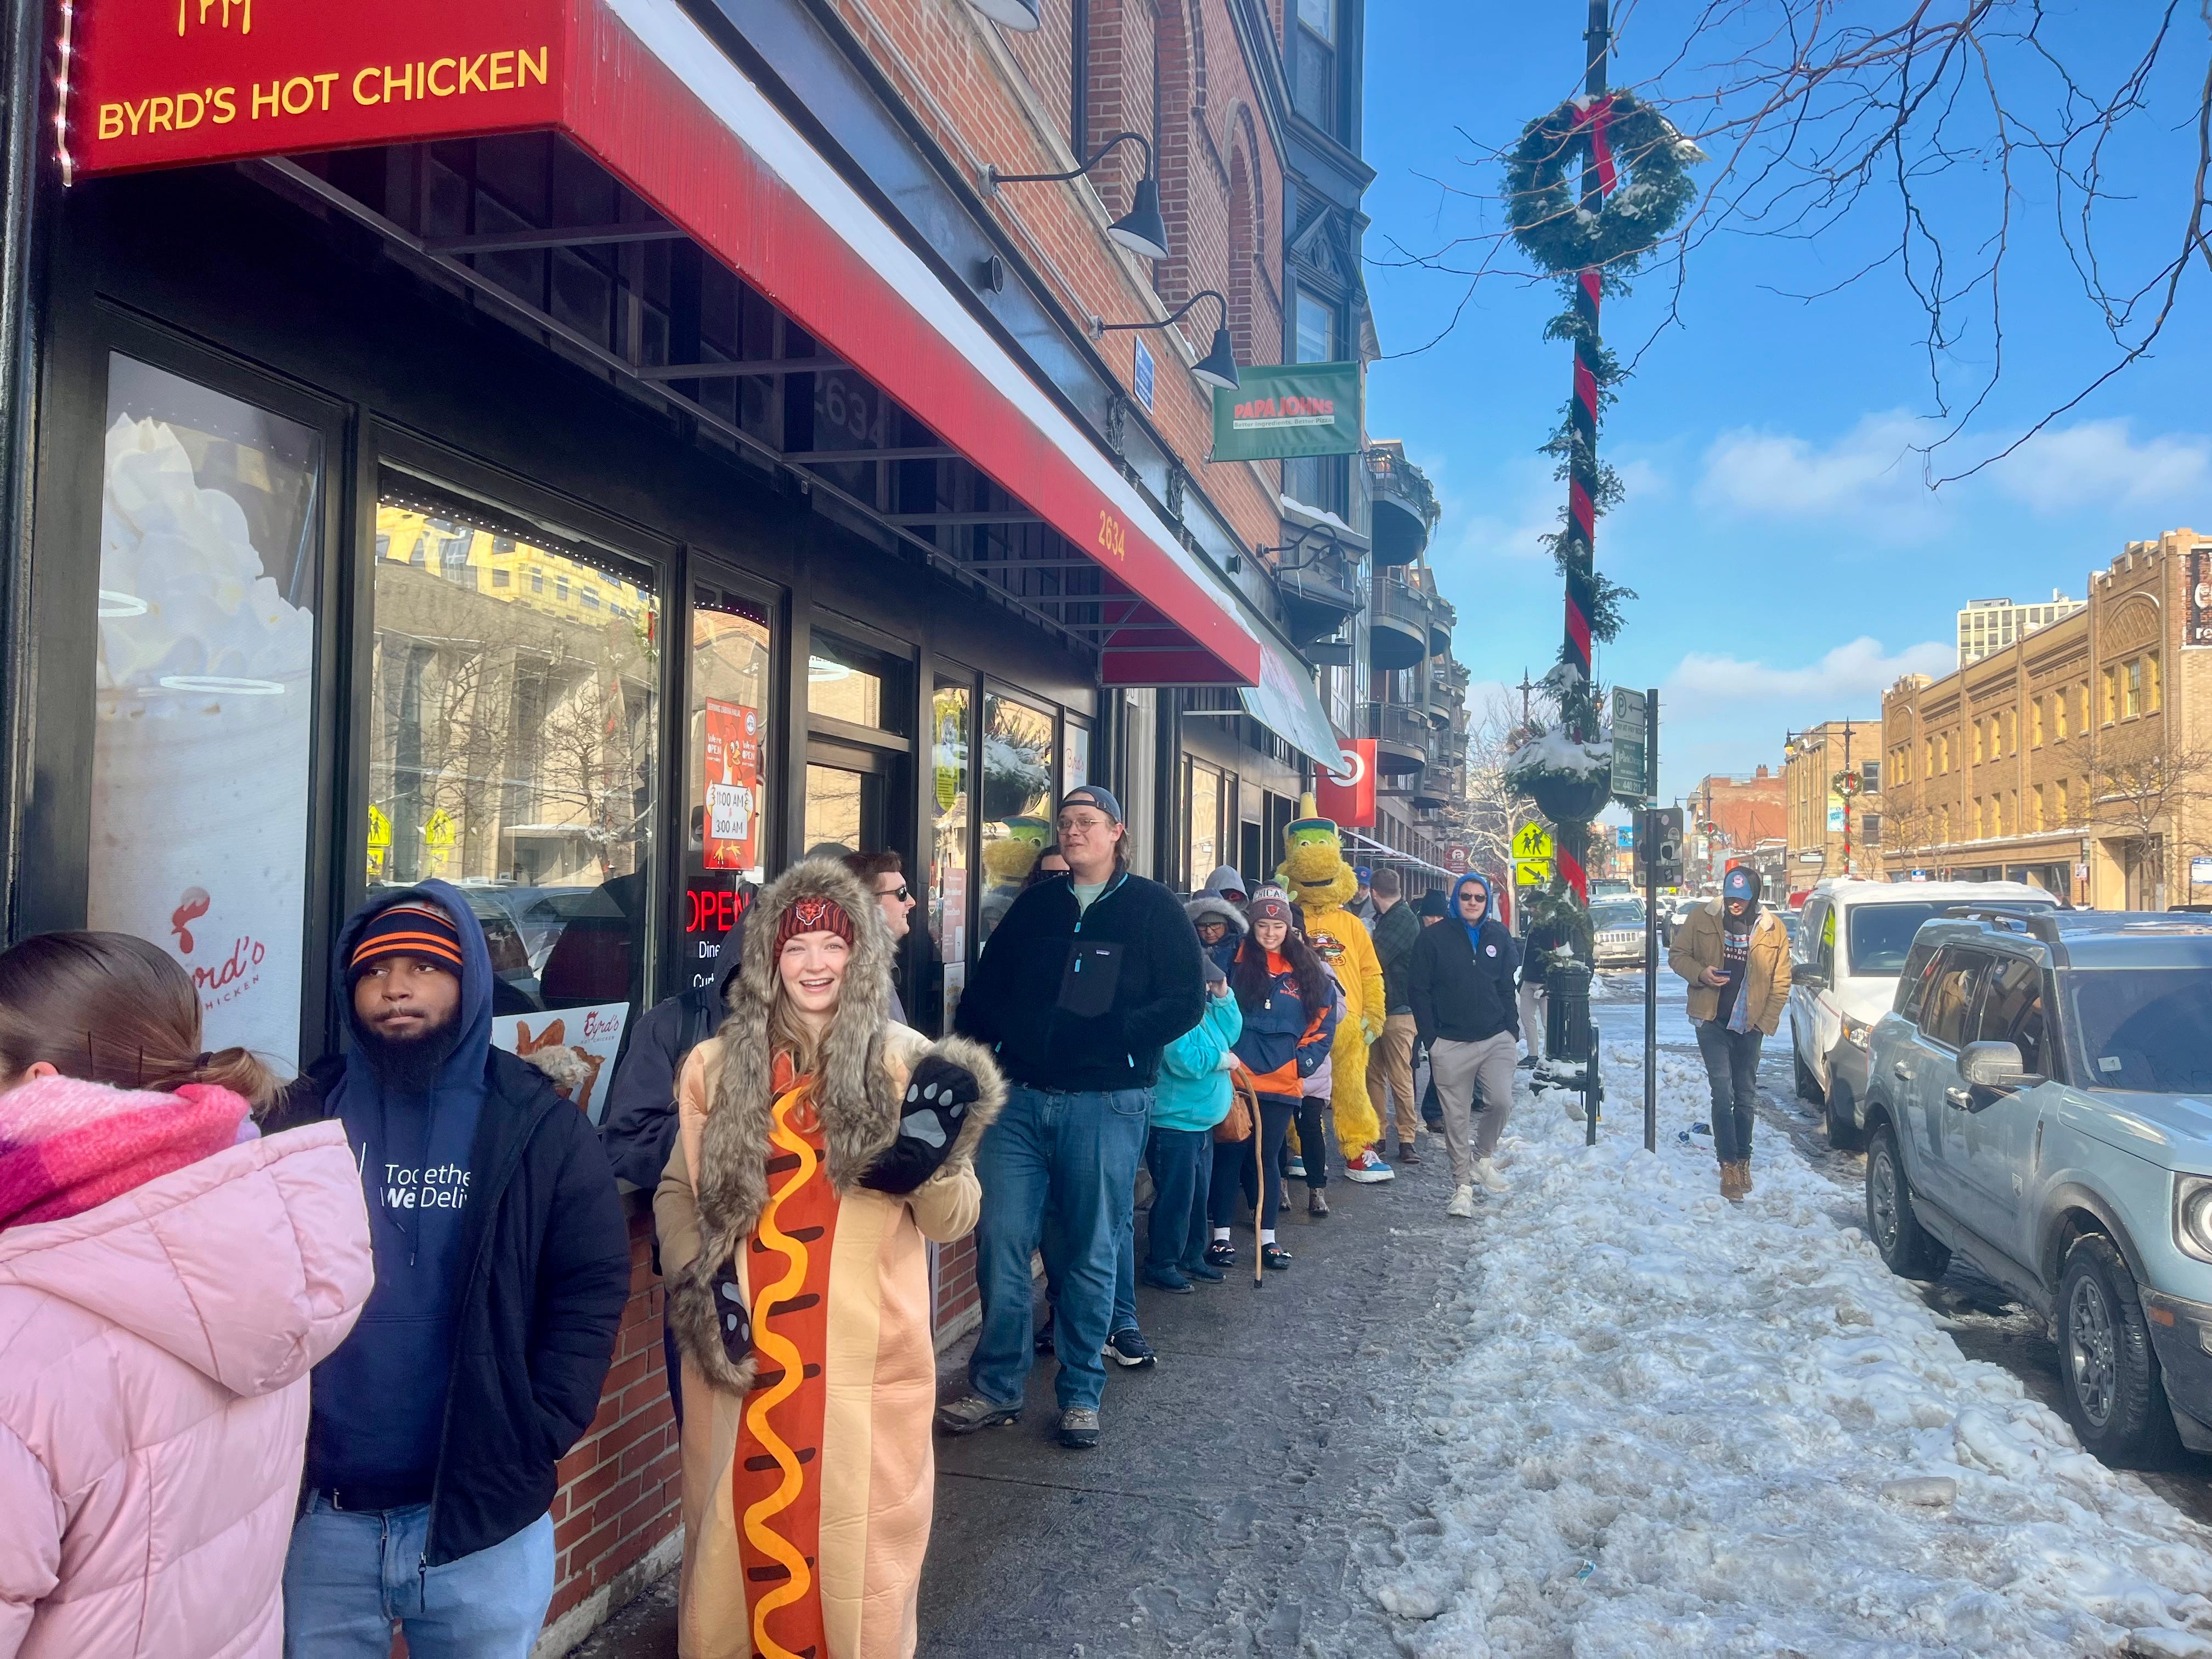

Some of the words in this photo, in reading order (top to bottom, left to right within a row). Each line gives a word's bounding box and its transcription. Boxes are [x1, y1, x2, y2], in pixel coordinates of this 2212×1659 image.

[251, 72, 340, 119] HOT
[352, 46, 548, 105] CHICKEN
[1234, 398, 1277, 419] PAPA
[1098, 509, 1125, 562] 2634
[707, 743, 721, 755] OPEN
[742, 750, 755, 760] OPEN
[1066, 748, 1084, 772] Byrd's
[1623, 781, 1633, 791] 440
[716, 791, 731, 806] 11:00
[732, 794, 744, 808] AM
[716, 820, 730, 833] 3:00
[732, 822, 743, 834] AM
[686, 890, 749, 933] OPEN
[205, 974, 259, 1010] HICKEN
[584, 1011, 619, 1040] Byrd's
[380, 1186, 416, 1209] We
